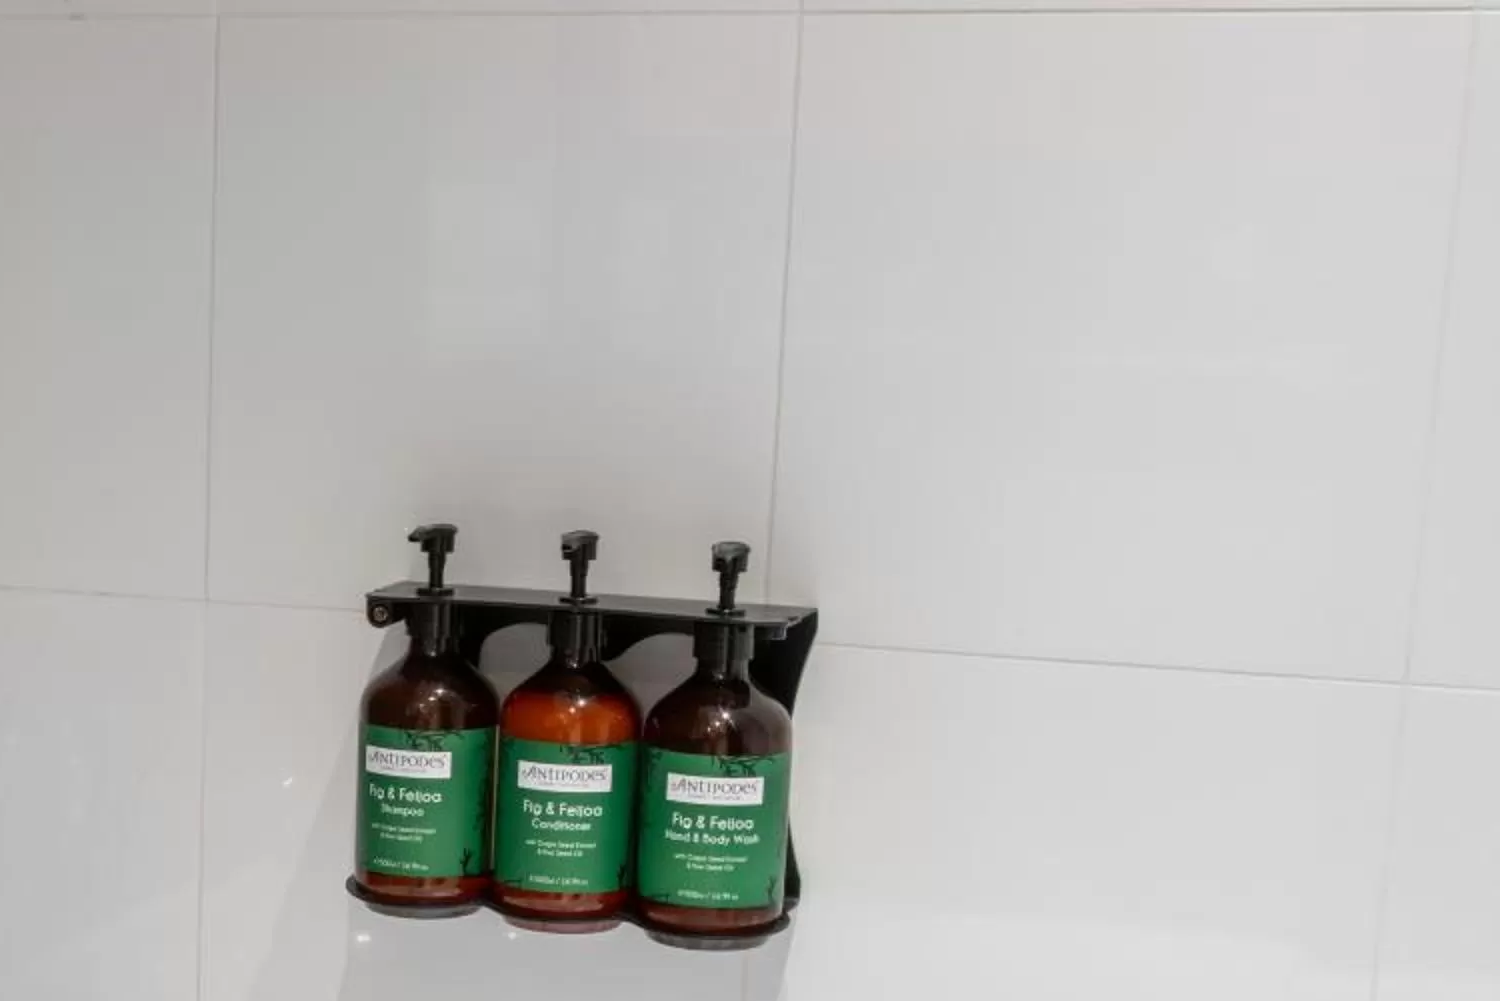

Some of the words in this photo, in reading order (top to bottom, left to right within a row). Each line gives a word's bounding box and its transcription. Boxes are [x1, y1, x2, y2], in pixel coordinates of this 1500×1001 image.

[369, 783, 385, 800] Fig
[388, 786, 395, 800] &
[523, 799, 543, 816] Fig
[546, 801, 555, 815] &
[672, 811, 693, 829] Fig
[695, 815, 706, 829] &
[702, 833, 730, 846] Body
